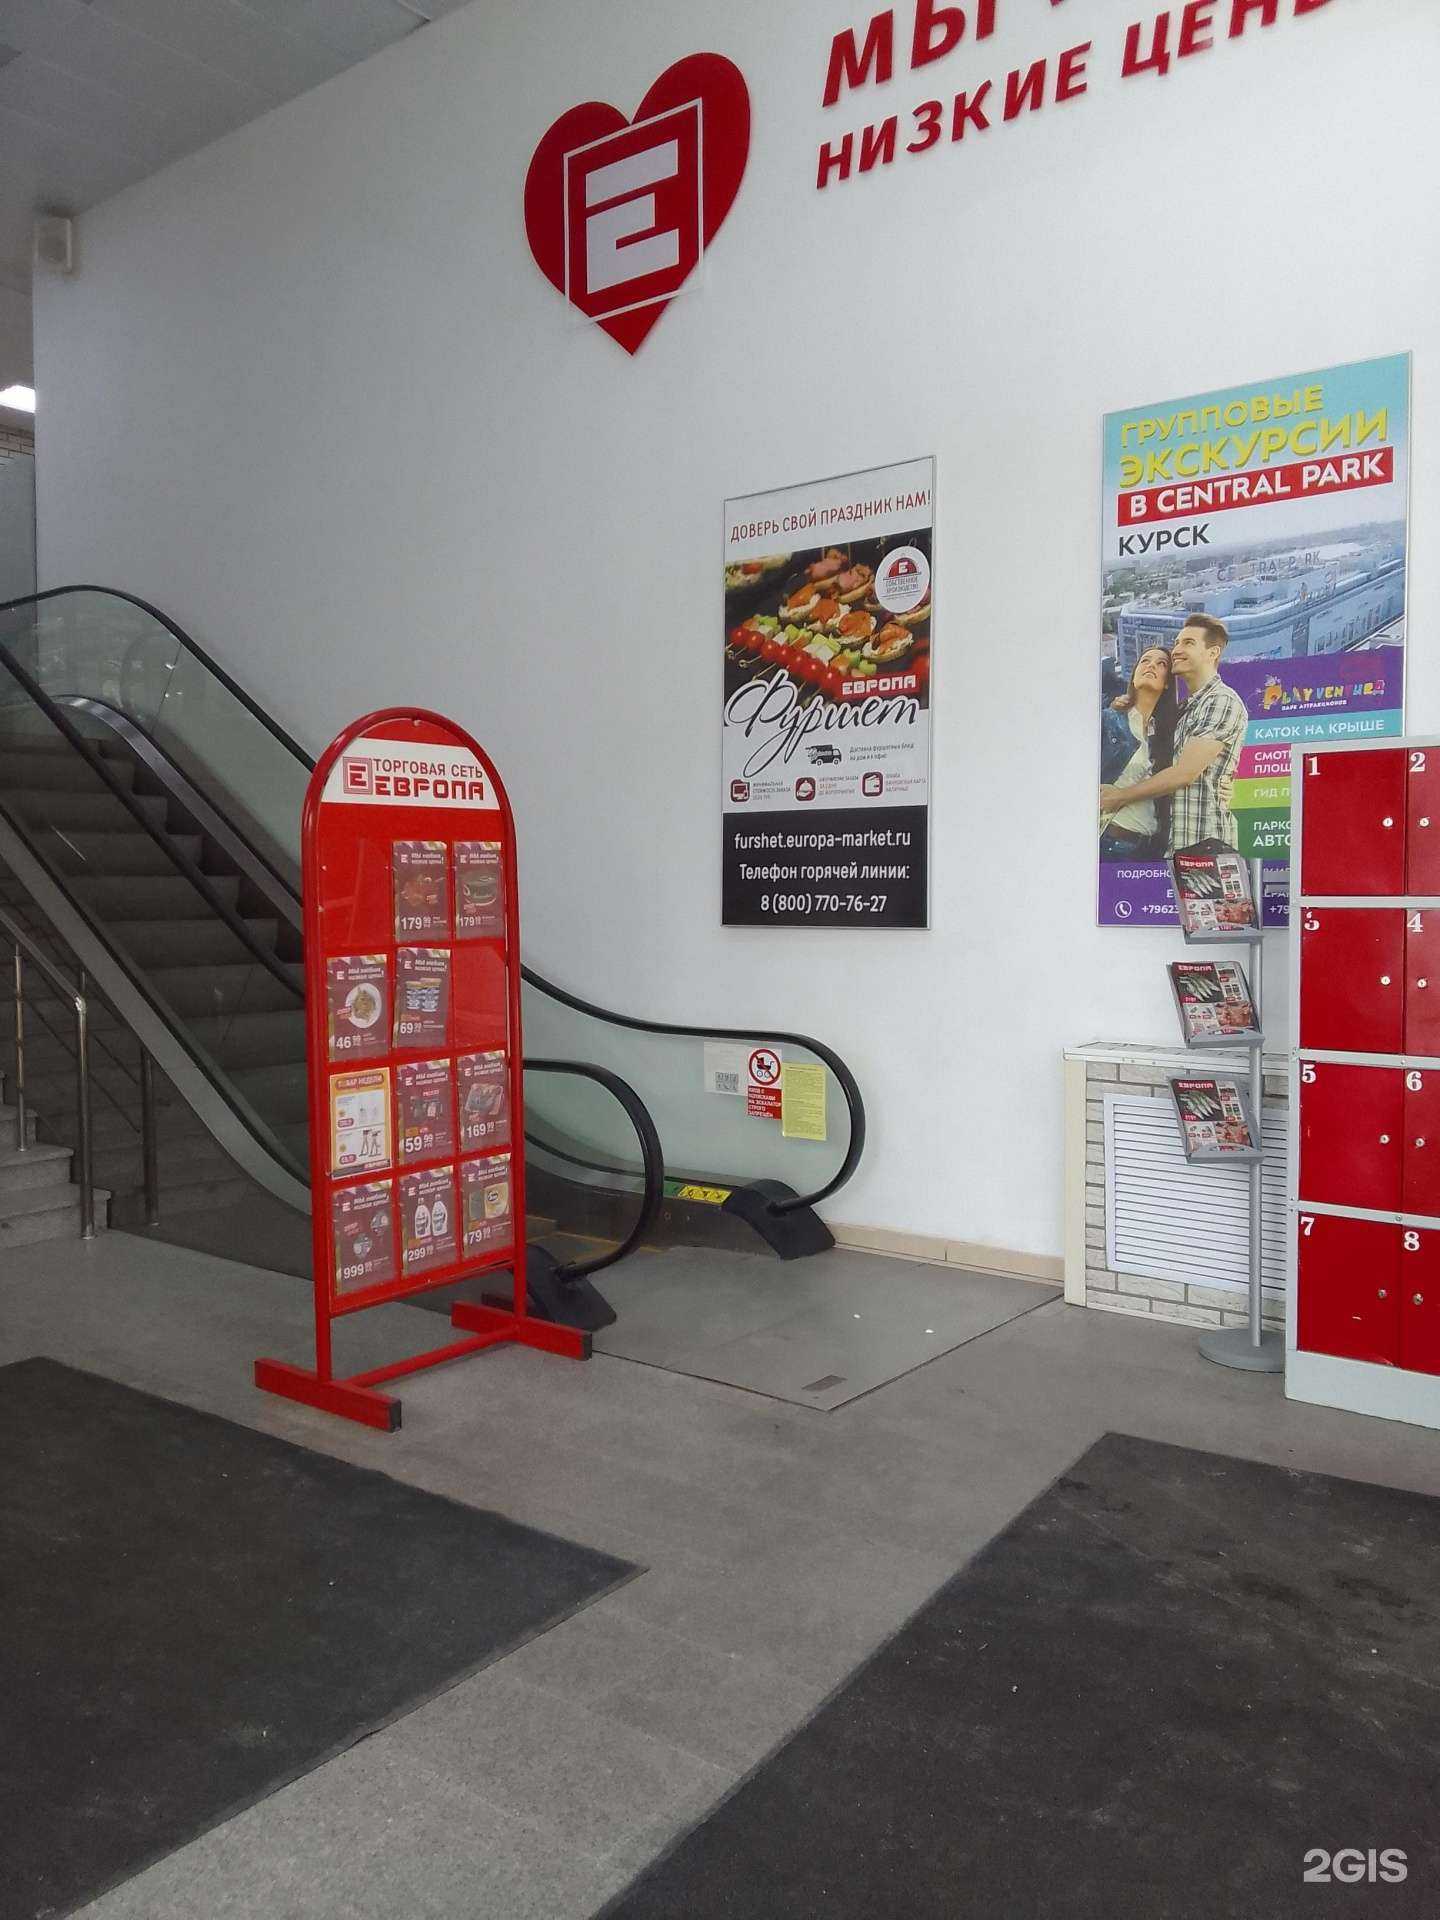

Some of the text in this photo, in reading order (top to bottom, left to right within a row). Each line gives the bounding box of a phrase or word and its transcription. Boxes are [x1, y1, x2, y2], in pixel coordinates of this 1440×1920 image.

[815, 0, 1338, 191] НИЗКИЕ ЦЕН
[1120, 384, 1324, 448] ГРУППОВЫЕ
[1118, 407, 1389, 489] ЭКСКУРСИИ
[1130, 452, 1385, 519] В CENTRAL PARK
[730, 489, 932, 544] ДОВЕРЬ СВОЙ ПРАЗДНИК НАМ!
[1118, 523, 1211, 557] КУРСК
[842, 674, 917, 696] ЕВРОПА
[727, 671, 918, 779] Фуршет
[1255, 719, 1385, 739] КАТОК НА КРЫШЕ
[1254, 750, 1291, 761] СМОТ
[1408, 752, 1426, 772] 2
[373, 758, 483, 779] ТОРГОВАЯ СЕТЬ
[1308, 756, 1321, 776] 1
[374, 776, 484, 801] ЕВРОПА
[1254, 788, 1278, 799] ГИД
[734, 829, 911, 851] furshet.europa-market.ru
[739, 861, 910, 882] Телефон горячей линии:
[760, 893, 887, 914] 8 (800) 770-76-27
[400, 916, 422, 930] 179
[459, 916, 475, 927] 179
[1406, 912, 1424, 933] 4
[400, 1022, 414, 1034] 69
[335, 1036, 352, 1049] 46
[1301, 1064, 1317, 1084] 5
[1406, 1070, 1423, 1091] 6
[467, 1123, 486, 1138] 169
[405, 1136, 422, 1152] 59
[1300, 1216, 1315, 1236] 7
[468, 1230, 482, 1244] 79
[1403, 1230, 1420, 1251] 8
[408, 1247, 426, 1262] 299
[343, 1263, 364, 1279] 999
